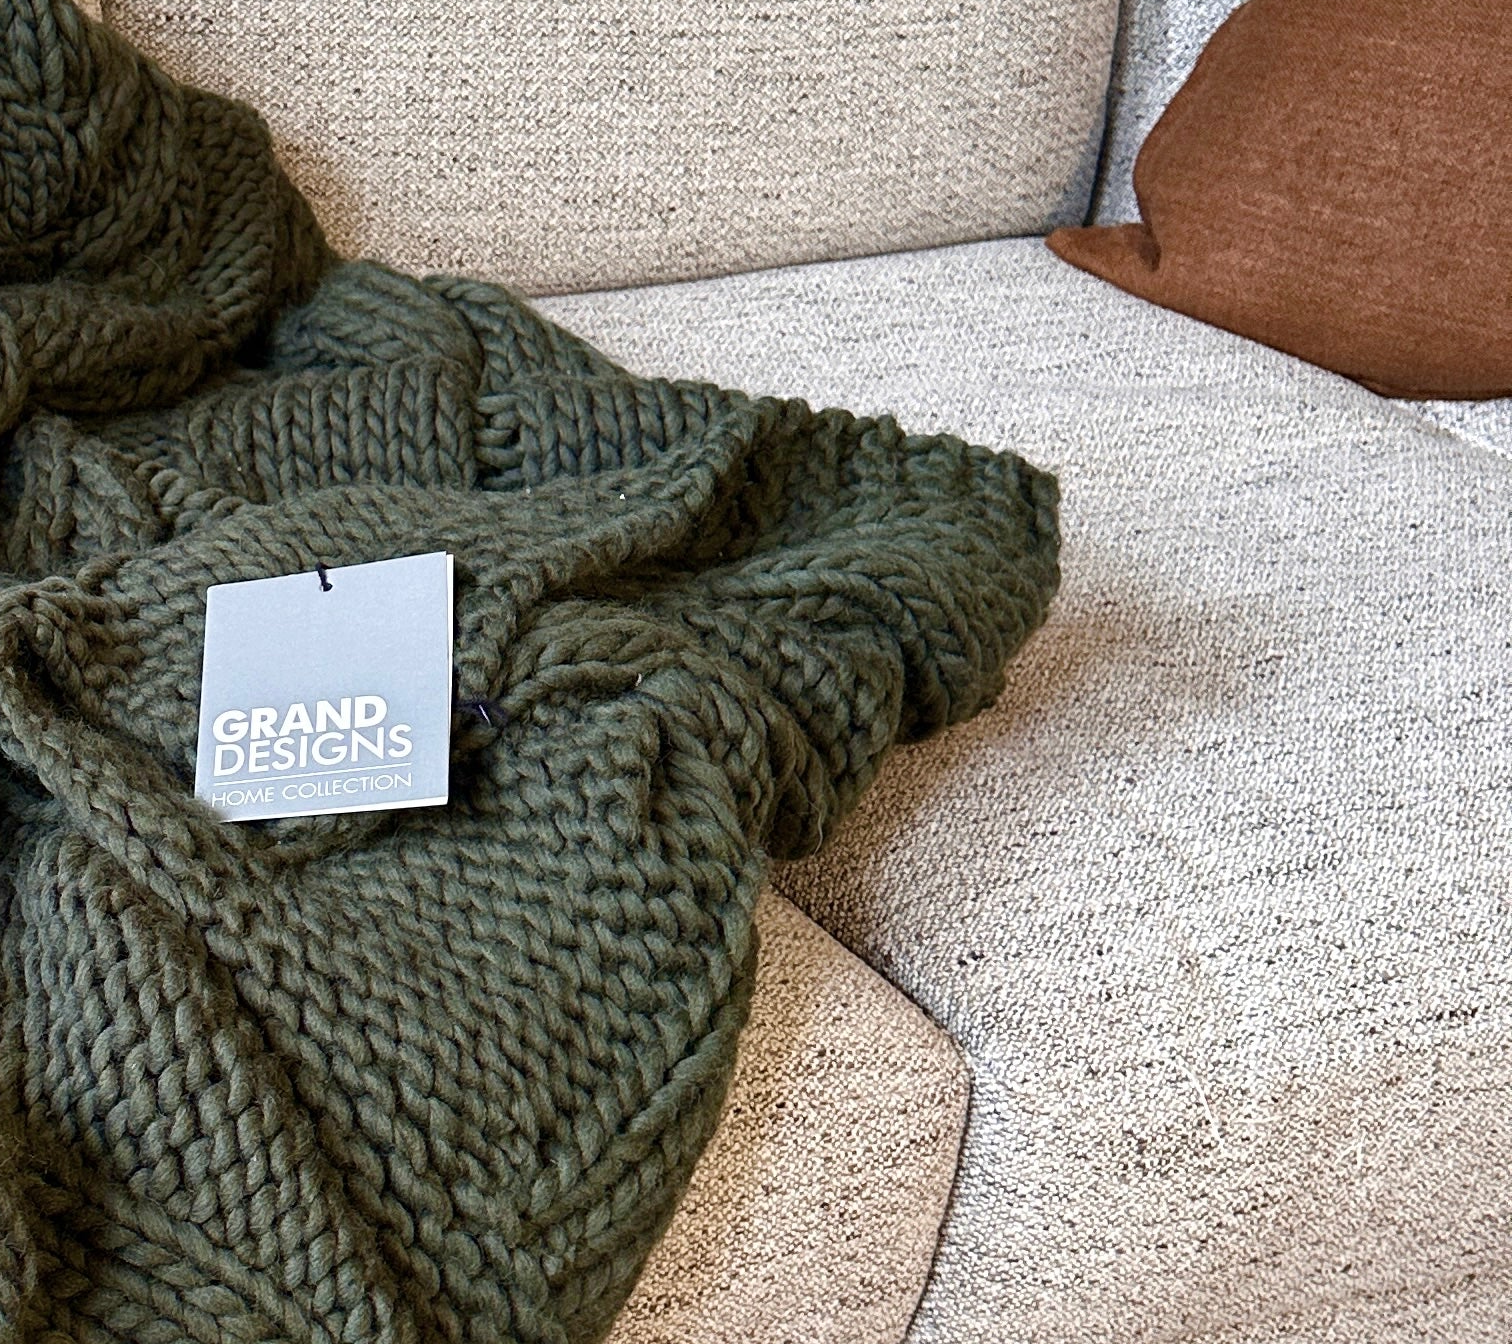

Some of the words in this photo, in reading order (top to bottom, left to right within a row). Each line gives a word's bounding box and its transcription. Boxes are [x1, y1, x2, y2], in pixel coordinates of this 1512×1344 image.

[212, 695, 388, 743] GRAND
[213, 724, 413, 777] DESIGNS
[211, 786, 275, 807] HOME
[282, 772, 412, 800] COLLECTION
